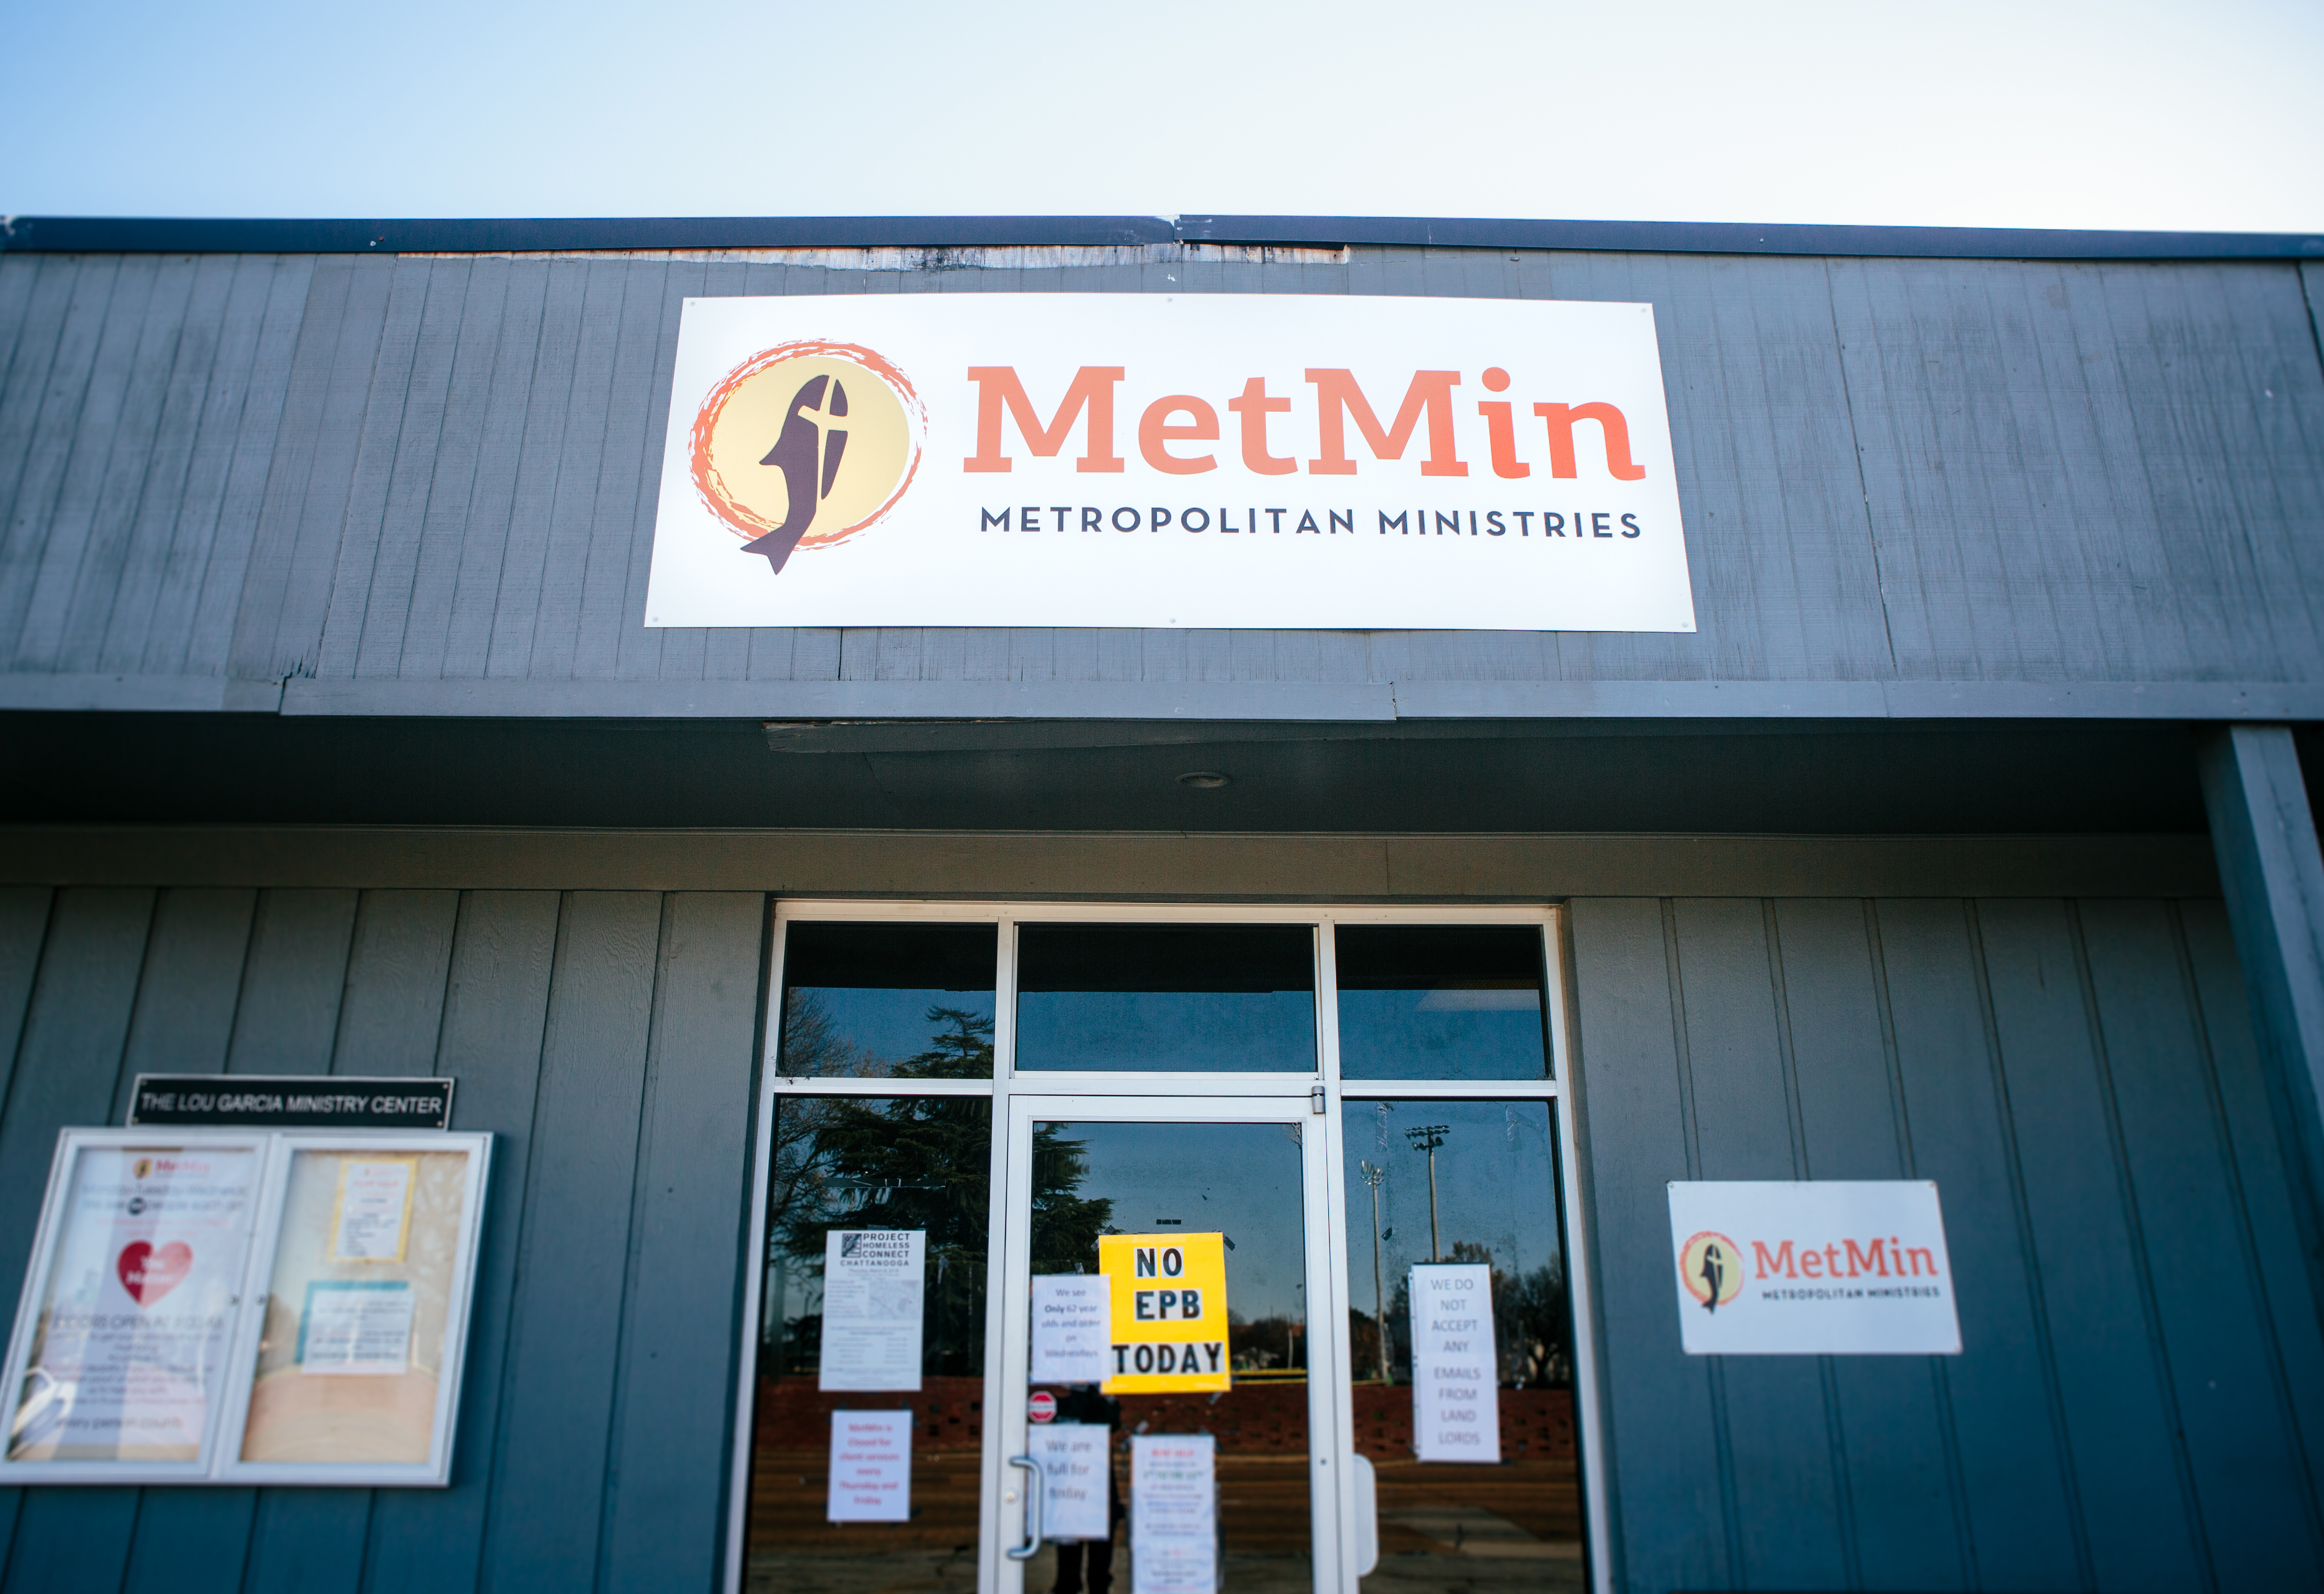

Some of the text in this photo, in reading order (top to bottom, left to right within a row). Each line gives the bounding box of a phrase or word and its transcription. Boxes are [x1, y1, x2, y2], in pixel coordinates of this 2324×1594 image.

[963, 366, 1646, 482] MetMin
[981, 507, 1642, 539] METROPOLITAN MINISTRIES
[141, 1093, 442, 1114] THE LOU GARCIA MINISTRY CENTER
[1137, 1248, 1182, 1277] NO
[1751, 1236, 1938, 1279] MetMin
[1431, 1279, 1474, 1291] WE DO
[1762, 1287, 1940, 1300] METROPOLITAN MINISTRIES
[1044, 1304, 1064, 1314] Only
[1079, 1306, 1097, 1314] year
[1136, 1291, 1200, 1320] EPB
[1441, 1299, 1467, 1311] NOT
[1061, 1319, 1077, 1328] and
[1432, 1320, 1478, 1332] ACCEPT
[1443, 1340, 1469, 1352] ANY
[1112, 1343, 1222, 1373] TODAY
[1434, 1367, 1480, 1380] EMAILS
[1439, 1388, 1478, 1401] FROM
[1441, 1409, 1477, 1423] LAND
[1439, 1431, 1480, 1445] LORDS
[1045, 1440, 1092, 1453] We are
[1047, 1462, 1089, 1476] full for
[1049, 1485, 1088, 1502] today
